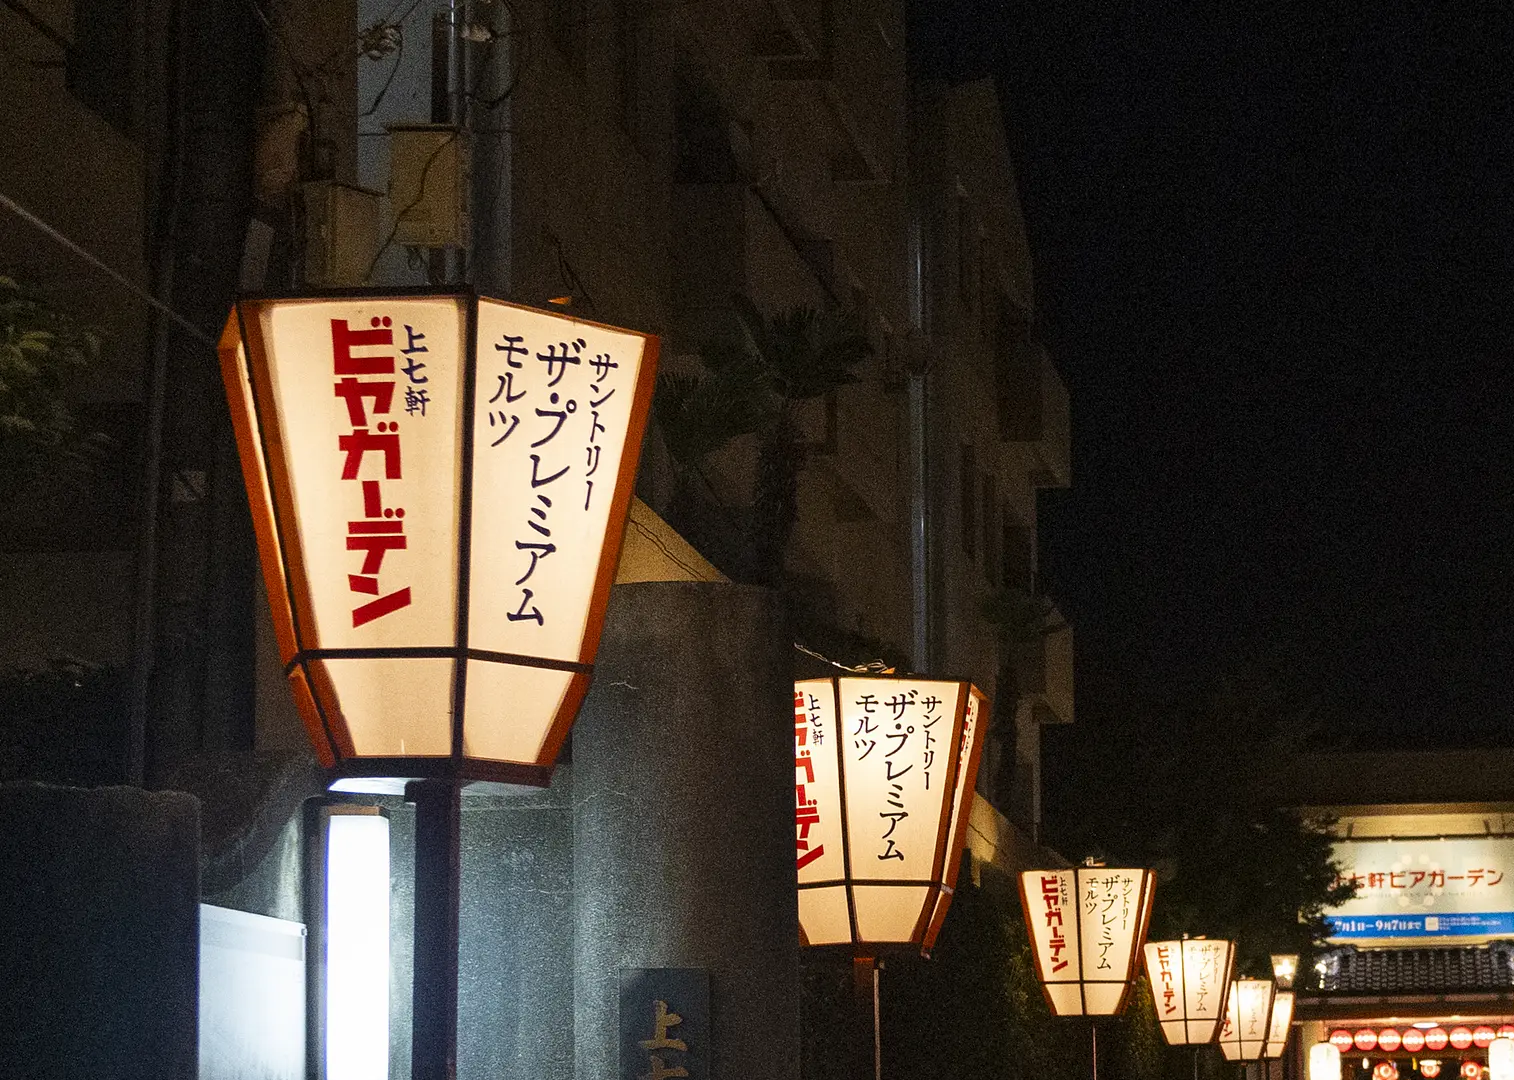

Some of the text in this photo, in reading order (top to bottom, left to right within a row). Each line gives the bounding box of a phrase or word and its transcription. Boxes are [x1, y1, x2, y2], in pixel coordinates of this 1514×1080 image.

[400, 323, 432, 417] 上七軒
[488, 332, 530, 448] モルツ
[329, 315, 412, 629] ビヤガーデン
[587, 352, 620, 512] サントリー
[506, 336, 587, 627] ザ・プレミアム
[807, 692, 825, 746] 上七軒
[853, 693, 880, 762] モルツ
[920, 694, 943, 791] サントリー
[876, 689, 919, 862] ザ・プレミアム
[1040, 875, 1069, 974] ビヤガーデン
[1084, 877, 1099, 916] モルツ
[1096, 874, 1121, 970] ザ・プレミアム
[1121, 877, 1134, 931] サントリー
